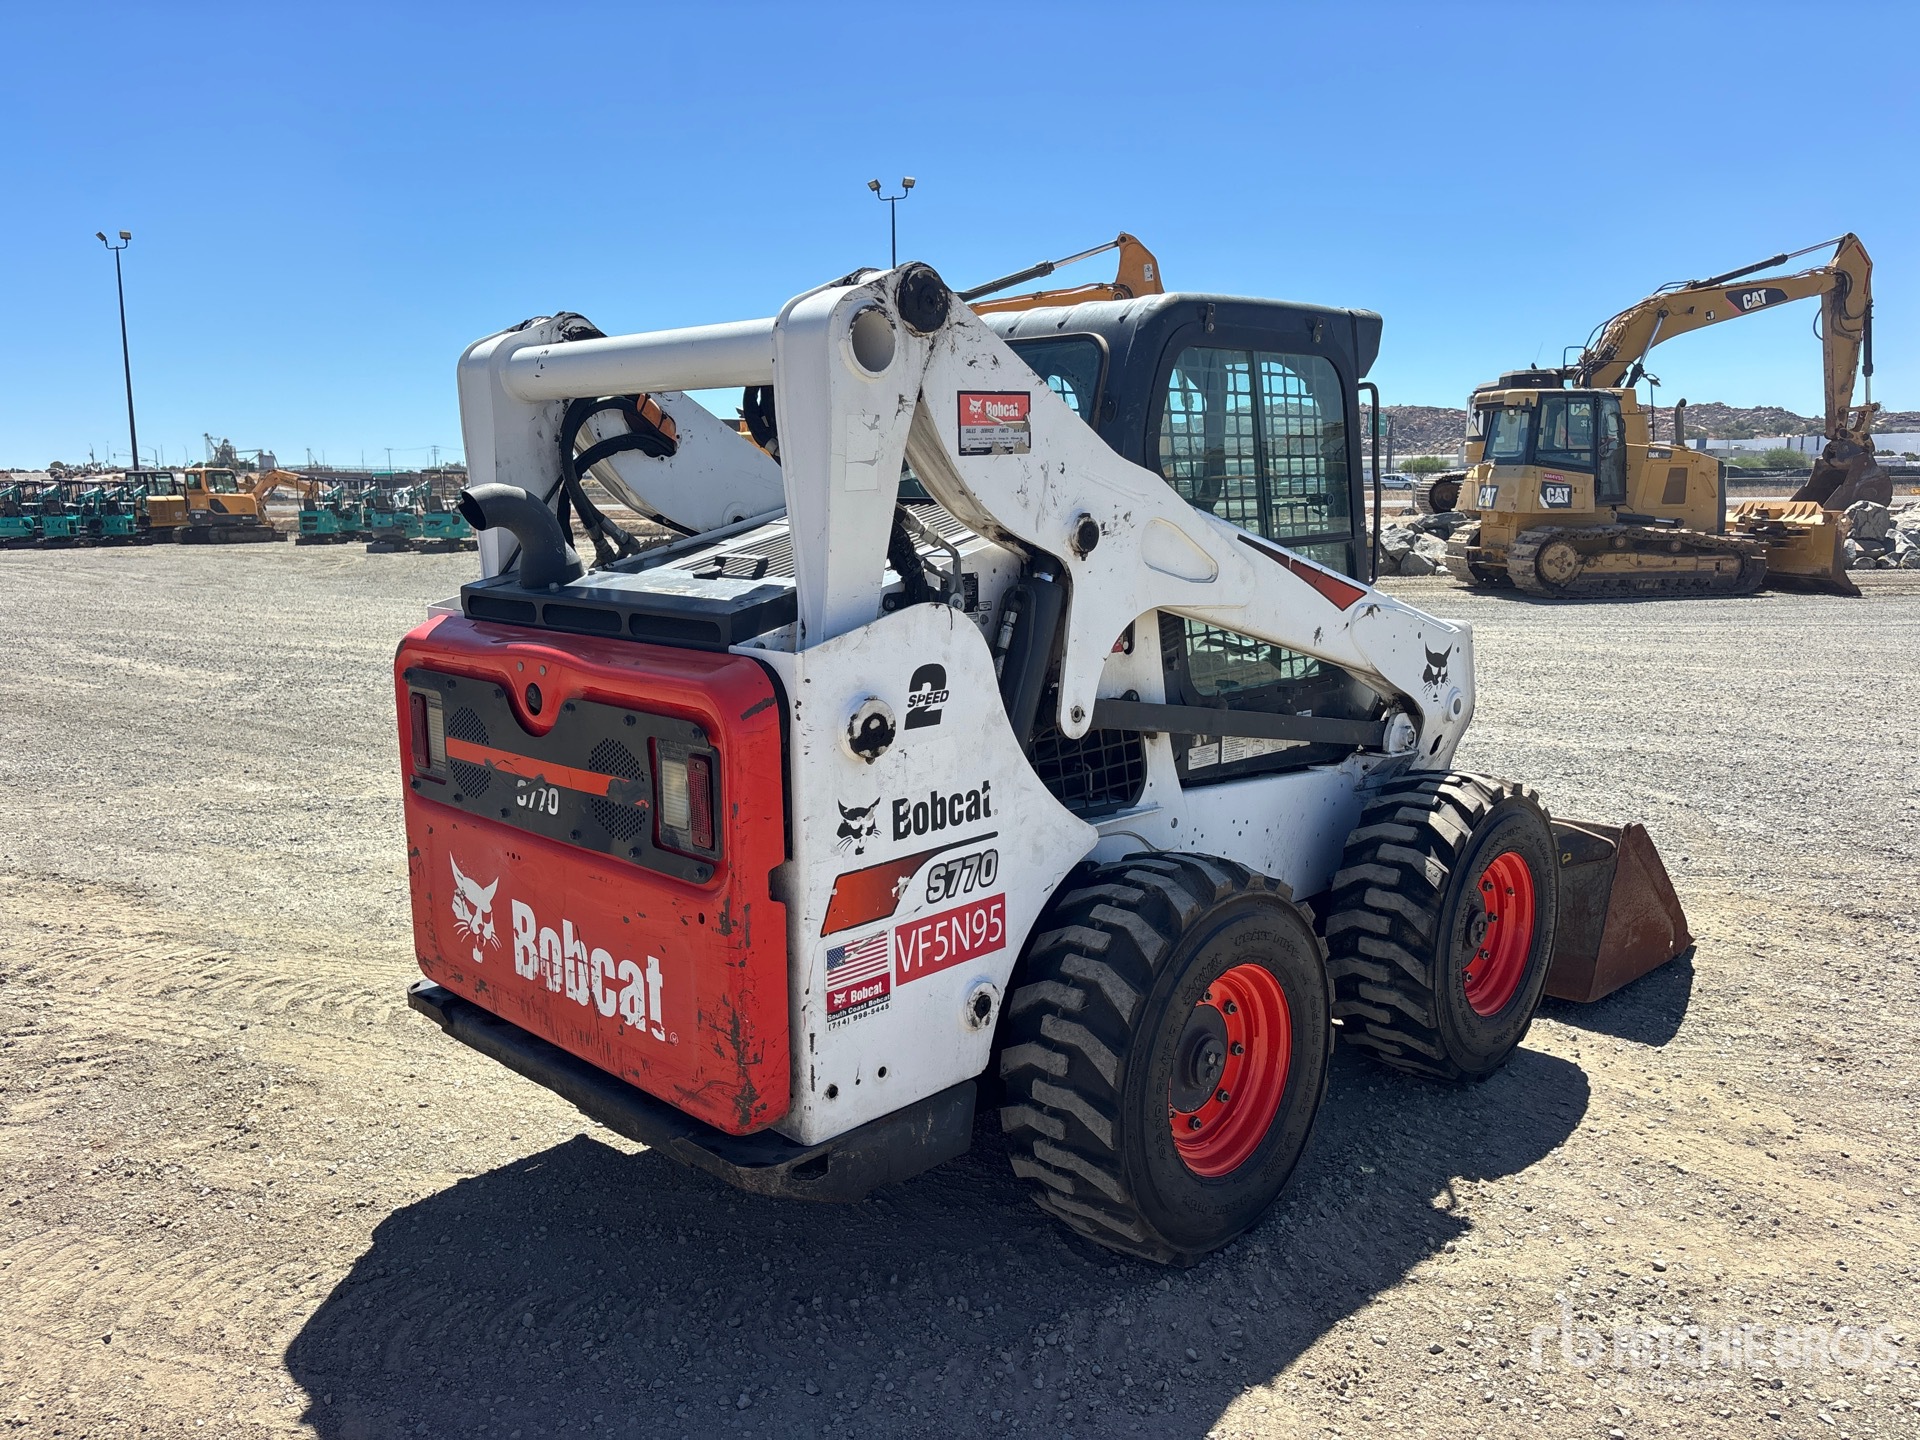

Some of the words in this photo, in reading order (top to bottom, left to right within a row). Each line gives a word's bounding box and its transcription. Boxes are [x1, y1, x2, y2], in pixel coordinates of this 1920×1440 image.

[1742, 289, 1767, 310] CAT
[985, 401, 1019, 417] Bobcat
[1478, 487, 1497, 506] CAT
[1546, 487, 1570, 504] CAT
[907, 689, 950, 709] SPEED
[892, 780, 992, 841] Bobcat
[925, 848, 999, 904] S770
[896, 903, 1003, 973] VF5N95
[510, 898, 667, 1043] Bobcat
[850, 981, 883, 1004] Bobcat
[827, 1010, 847, 1021] South
[847, 1003, 867, 1014] Coast
[868, 994, 891, 1007] Bobcat
[828, 1017, 850, 1032] (714)
[852, 1002, 890, 1022] 998-5445
